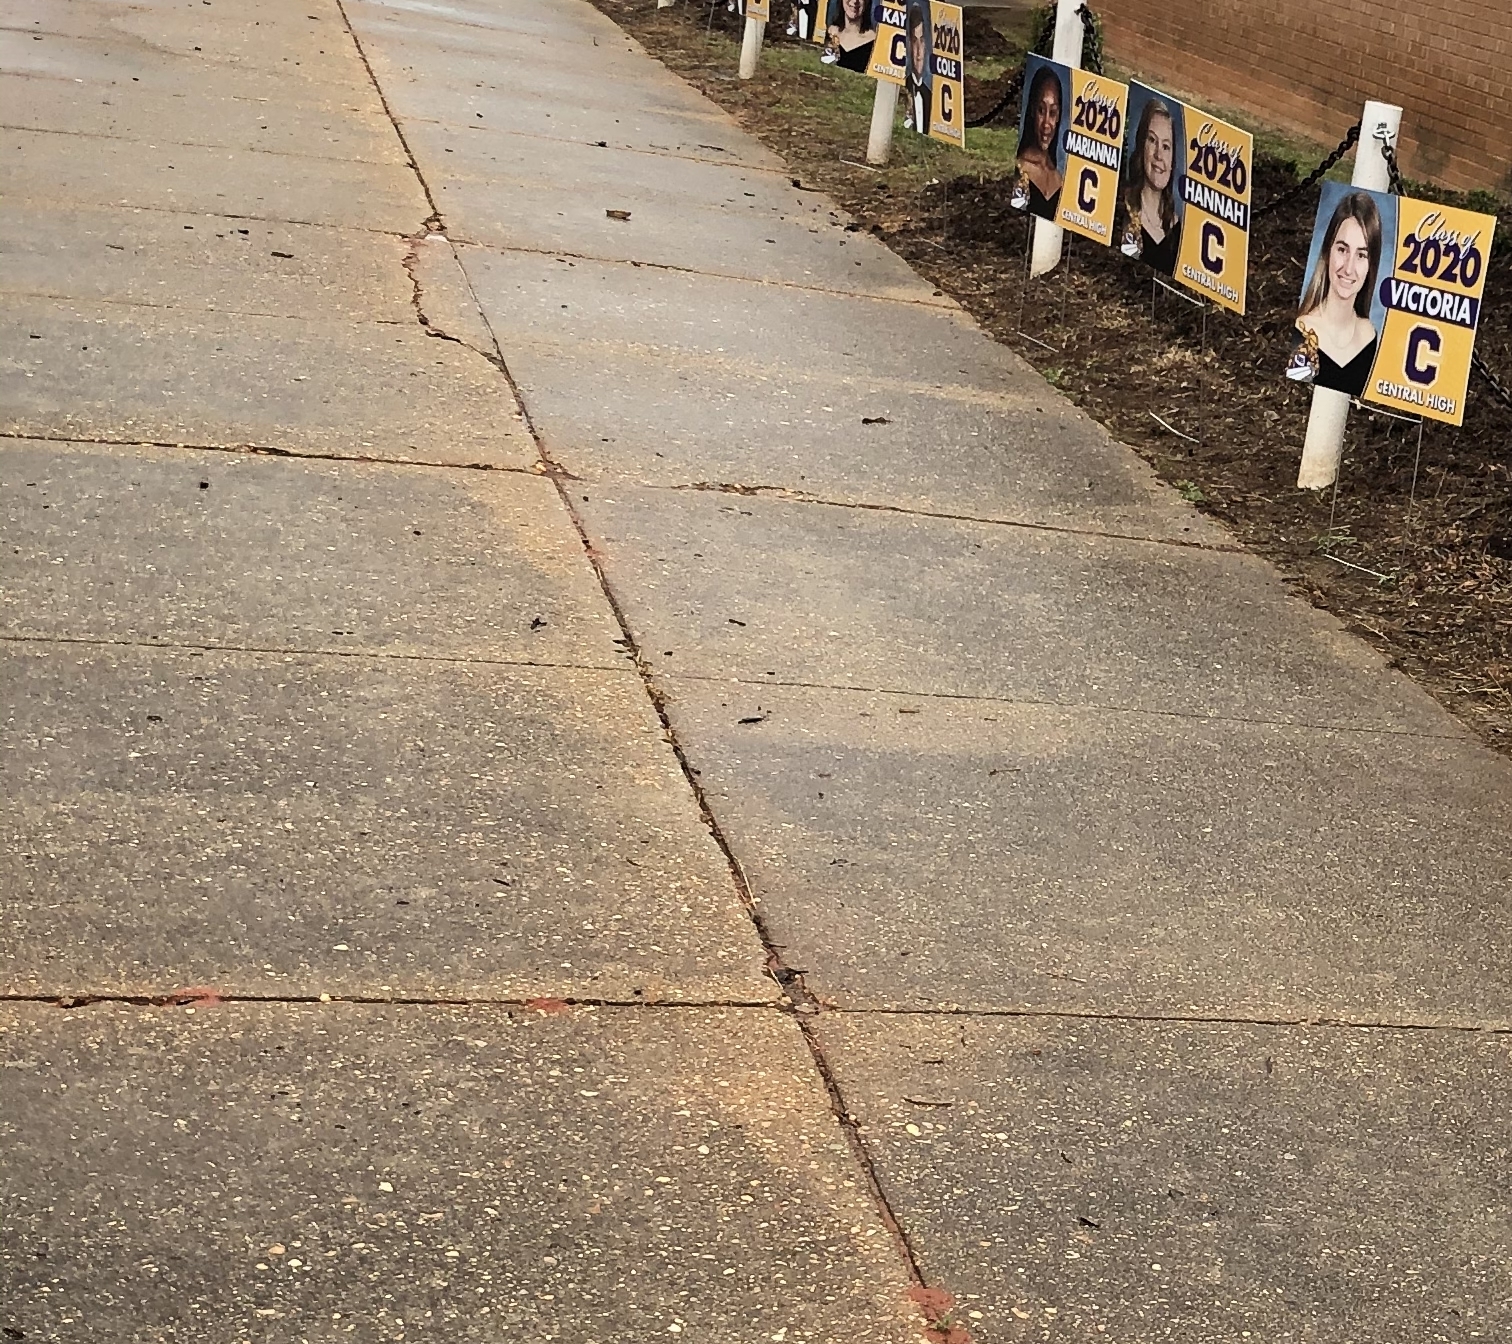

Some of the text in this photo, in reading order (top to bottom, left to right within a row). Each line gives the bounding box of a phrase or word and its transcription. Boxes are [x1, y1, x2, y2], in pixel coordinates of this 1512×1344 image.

[934, 22, 960, 56] 2020
[936, 57, 956, 78] COLE
[941, 83, 953, 123] C
[1073, 95, 1121, 140] 2020
[1066, 131, 1118, 168] MARIANNA
[1196, 121, 1229, 154] Class
[1189, 137, 1247, 195] 2020
[1077, 166, 1099, 215] C
[1184, 177, 1245, 227] HANNAH
[1062, 208, 1107, 238] CENTRAL HIGH
[1414, 209, 1482, 260] Class of
[1200, 220, 1225, 277] C
[1397, 232, 1482, 288] 2020
[1182, 264, 1239, 304] CENTRAL HIGH
[1390, 279, 1471, 325] VICTORIA
[1403, 324, 1442, 387] C
[1375, 379, 1457, 416] CENTRAL HIGH
